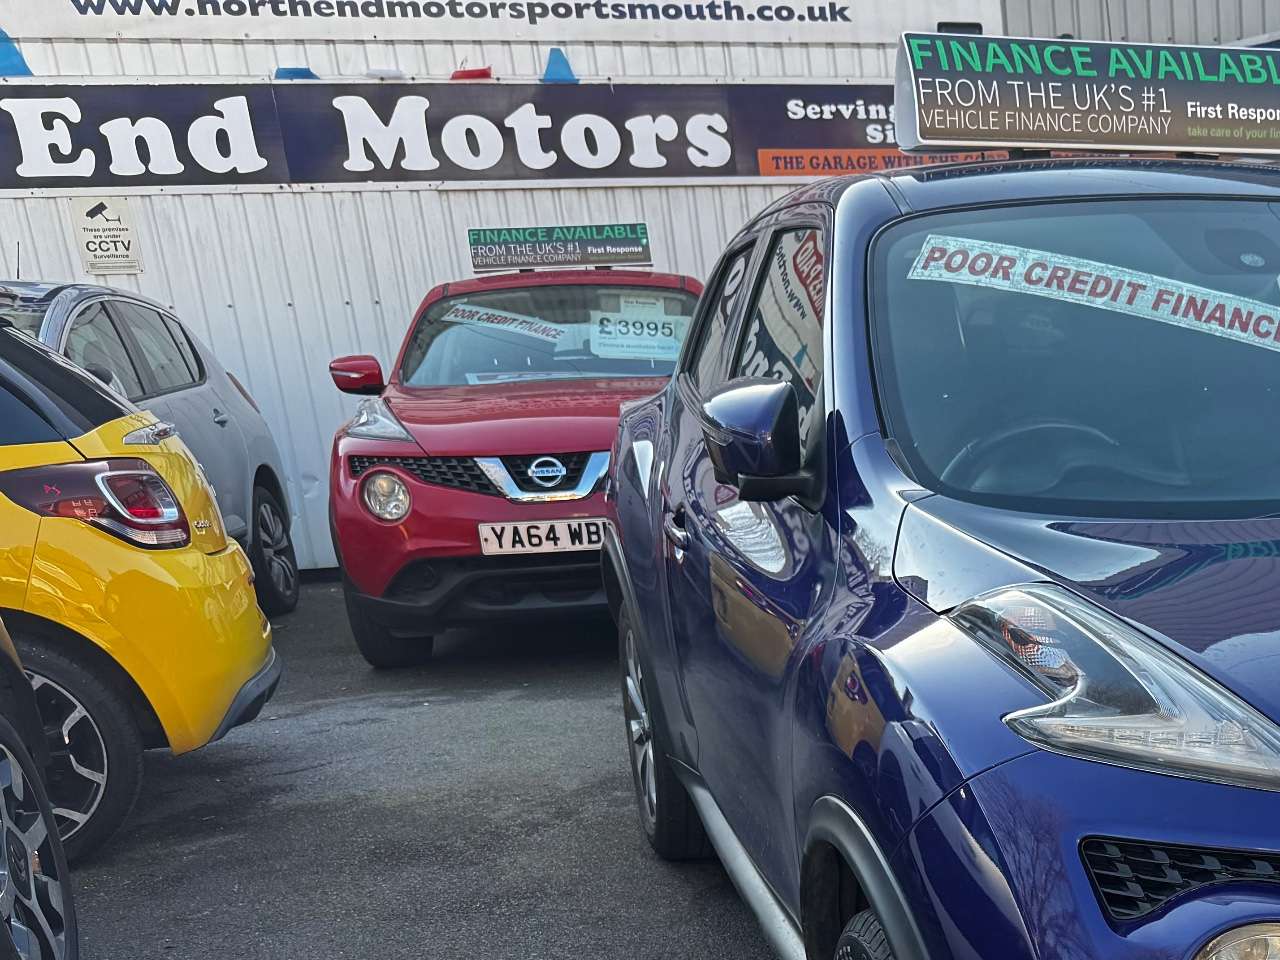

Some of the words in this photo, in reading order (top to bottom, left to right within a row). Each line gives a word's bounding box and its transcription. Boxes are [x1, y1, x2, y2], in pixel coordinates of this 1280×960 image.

[71, 0, 851, 24] www.northendmotorsportsmouth.co.uk
[909, 39, 1098, 78] FINANCE
[919, 78, 1000, 106] FROM
[1007, 81, 1063, 108] THE
[1072, 83, 1135, 112] UK'S
[1142, 88, 1172, 113] #1
[1187, 101, 1223, 119] First
[921, 109, 999, 131] VEHICLE
[1004, 112, 1083, 132] FINANCE
[1087, 114, 1172, 135] COMPANY
[0, 96, 268, 177] End
[332, 96, 732, 172] Motors
[1187, 126, 1208, 137] take
[1210, 127, 1231, 137] care
[1233, 126, 1243, 137] of
[1246, 129, 1267, 140] your
[772, 155, 806, 170] THE
[809, 155, 878, 170] GARAGE
[881, 155, 924, 169] WITH
[469, 229, 547, 244] FINANCE
[553, 225, 647, 240] AVAILABLE
[85, 239, 131, 253] CCTV
[471, 244, 509, 257] FROM
[511, 243, 537, 255] THE
[537, 242, 565, 255] UK'S
[567, 241, 580, 254] #1
[588, 245, 605, 254] First
[606, 245, 643, 254] Response
[473, 255, 506, 265] VEHICLE
[508, 254, 543, 264] FINANCE
[544, 253, 582, 263] COMPANY
[922, 246, 1017, 281] POOR
[1023, 262, 1148, 306] CREDIT
[451, 306, 477, 322] POOR
[476, 311, 518, 329] CREDIT
[517, 319, 565, 340] FINANCE
[598, 316, 674, 337] £3995
[532, 467, 563, 476] NISSAN
[491, 524, 561, 549] YA64
